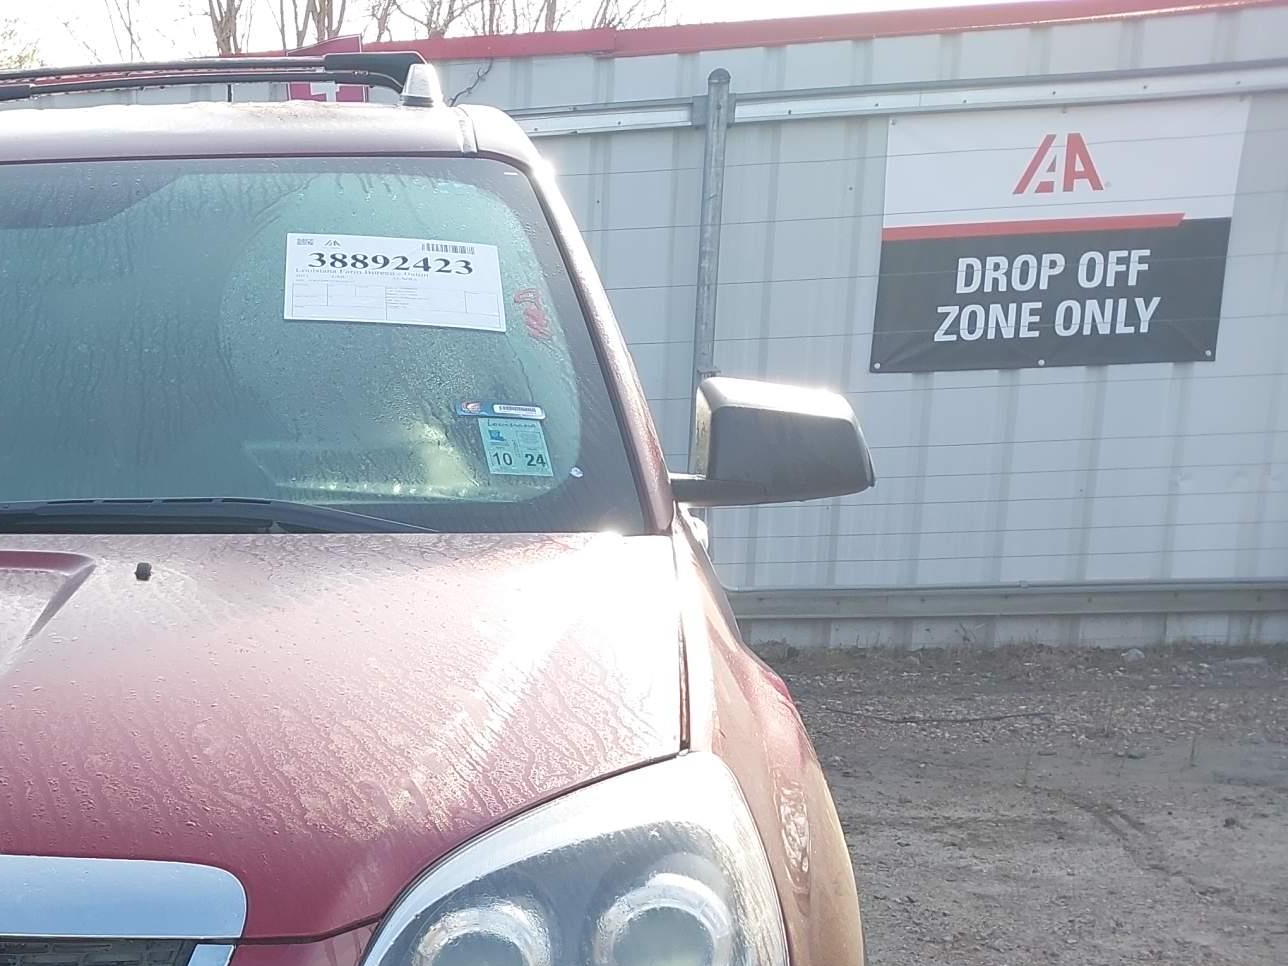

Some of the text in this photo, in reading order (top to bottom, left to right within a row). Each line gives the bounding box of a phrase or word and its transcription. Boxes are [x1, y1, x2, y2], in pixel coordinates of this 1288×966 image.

[307, 251, 474, 276] 38892423
[955, 249, 1152, 295] DROP OFF
[933, 296, 1162, 342] ZONE ONLY
[492, 452, 547, 468] 10 24
